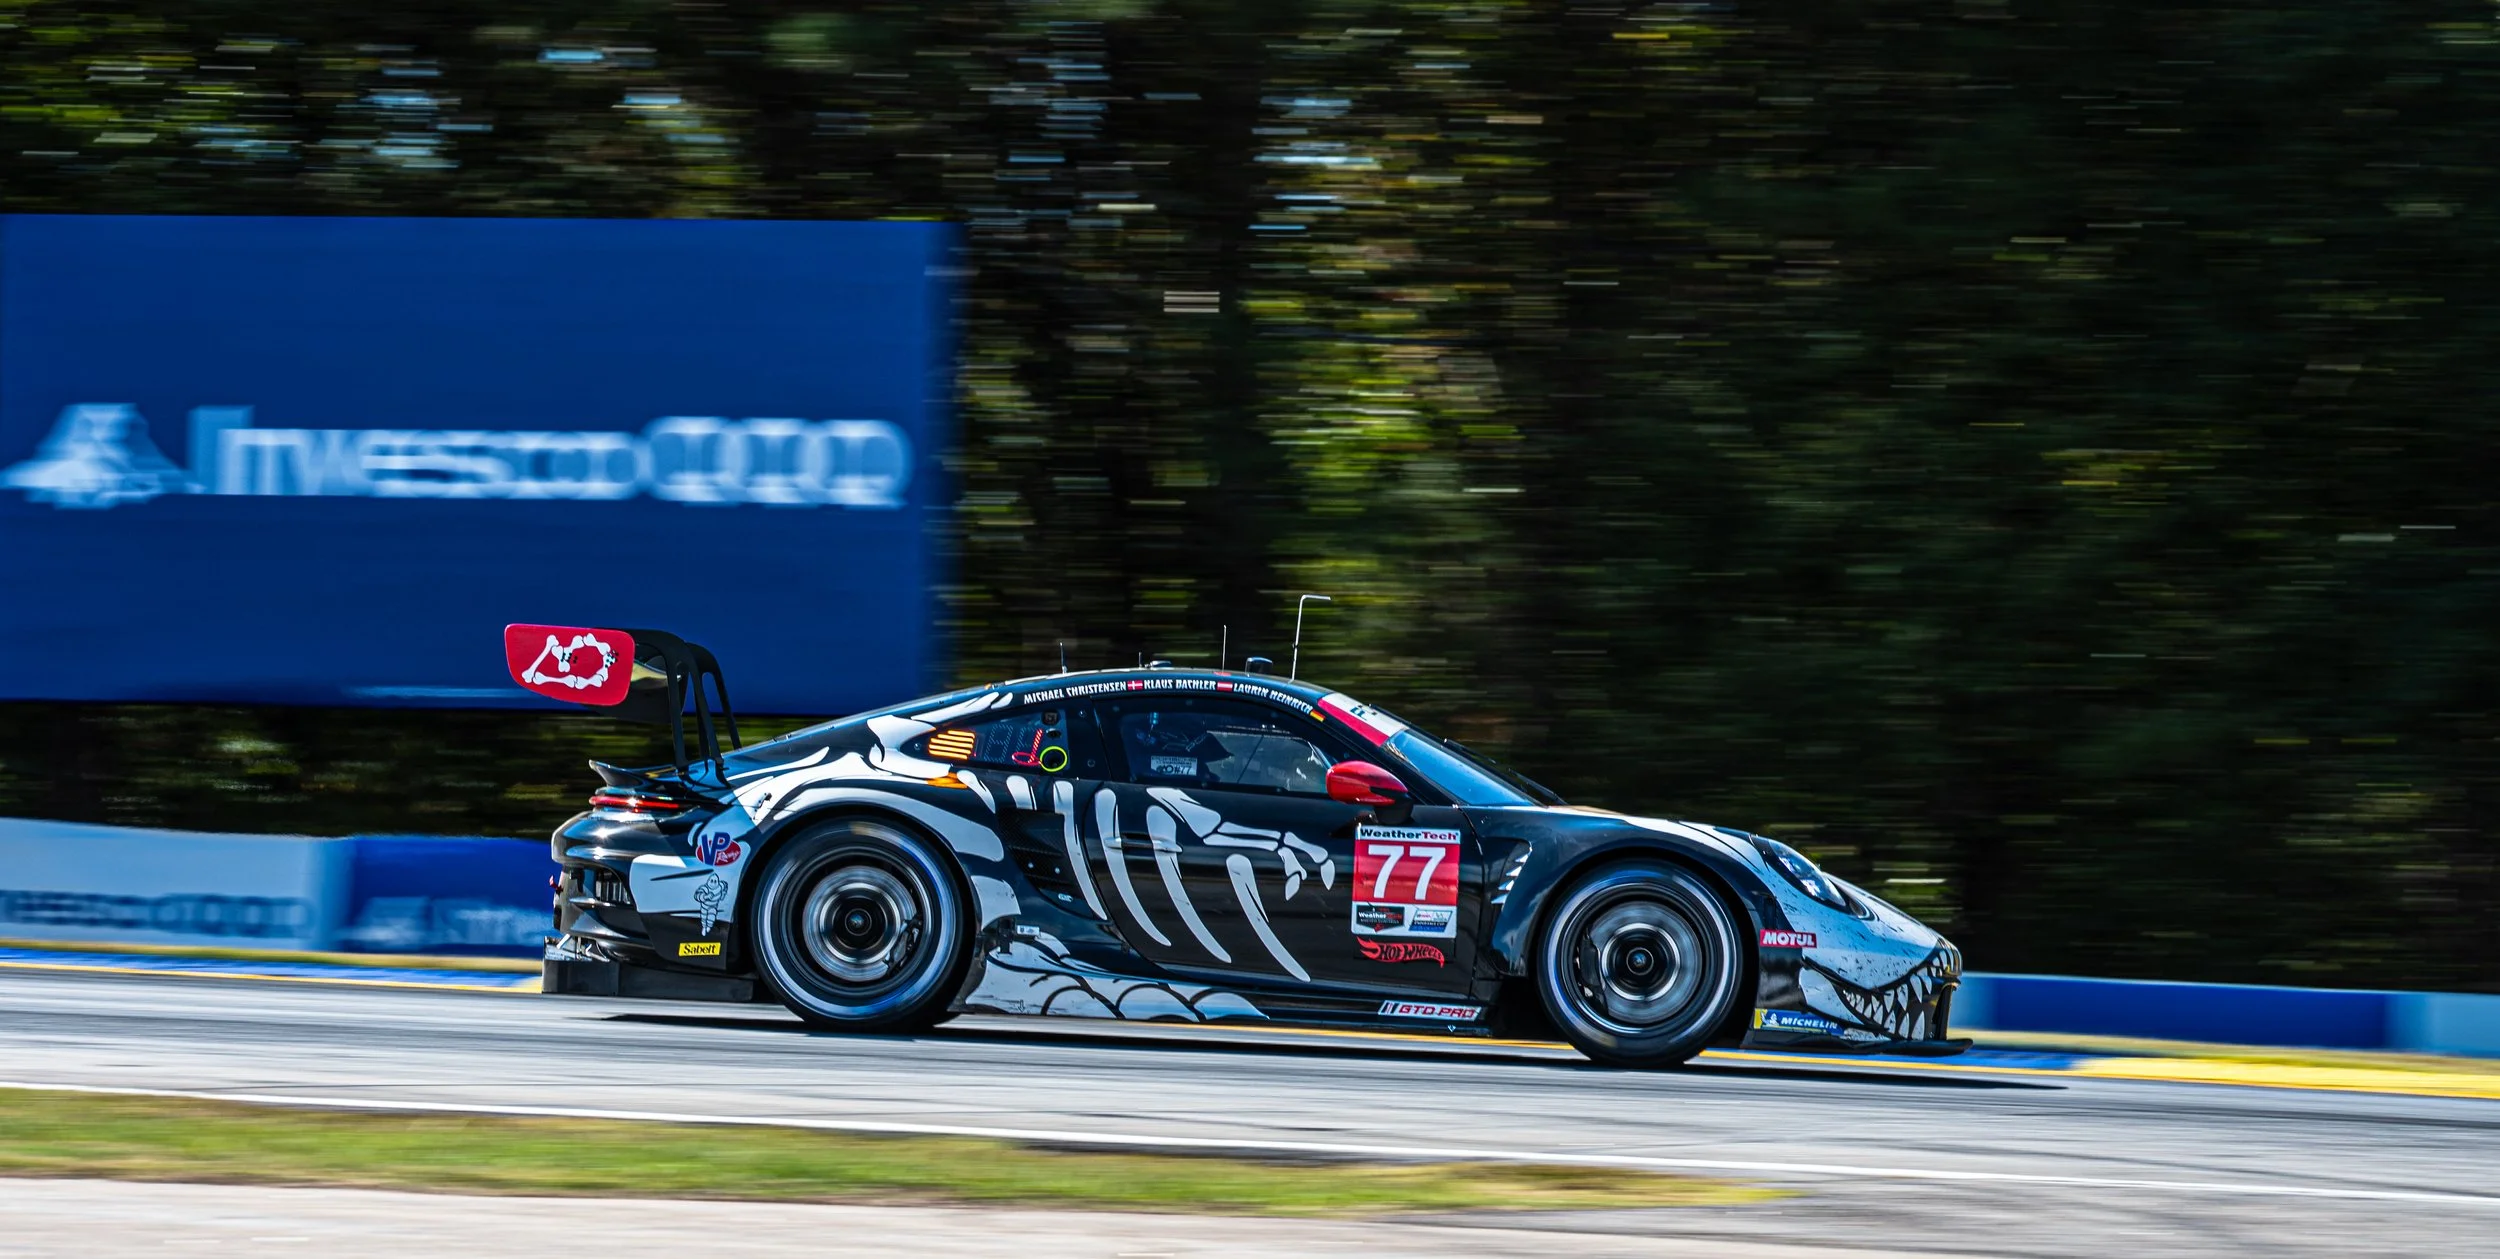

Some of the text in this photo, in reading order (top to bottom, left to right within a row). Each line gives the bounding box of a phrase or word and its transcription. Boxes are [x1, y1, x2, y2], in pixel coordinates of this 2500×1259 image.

[1023, 681, 1126, 704] MICHAEL CHRISTENSEN
[1144, 679, 1216, 691] KLAUS BACHLER
[1233, 683, 1313, 714] LAURIN HEINRICH
[1360, 828, 1457, 840] WeatherTech
[701, 831, 731, 866] VP
[1368, 844, 1446, 901] 77
[1763, 932, 1815, 946] MOTUL
[1379, 943, 1403, 961] HOT
[1399, 1004, 1476, 1018] GTD PRO
[1781, 1016, 1839, 1029] MICHELIN
